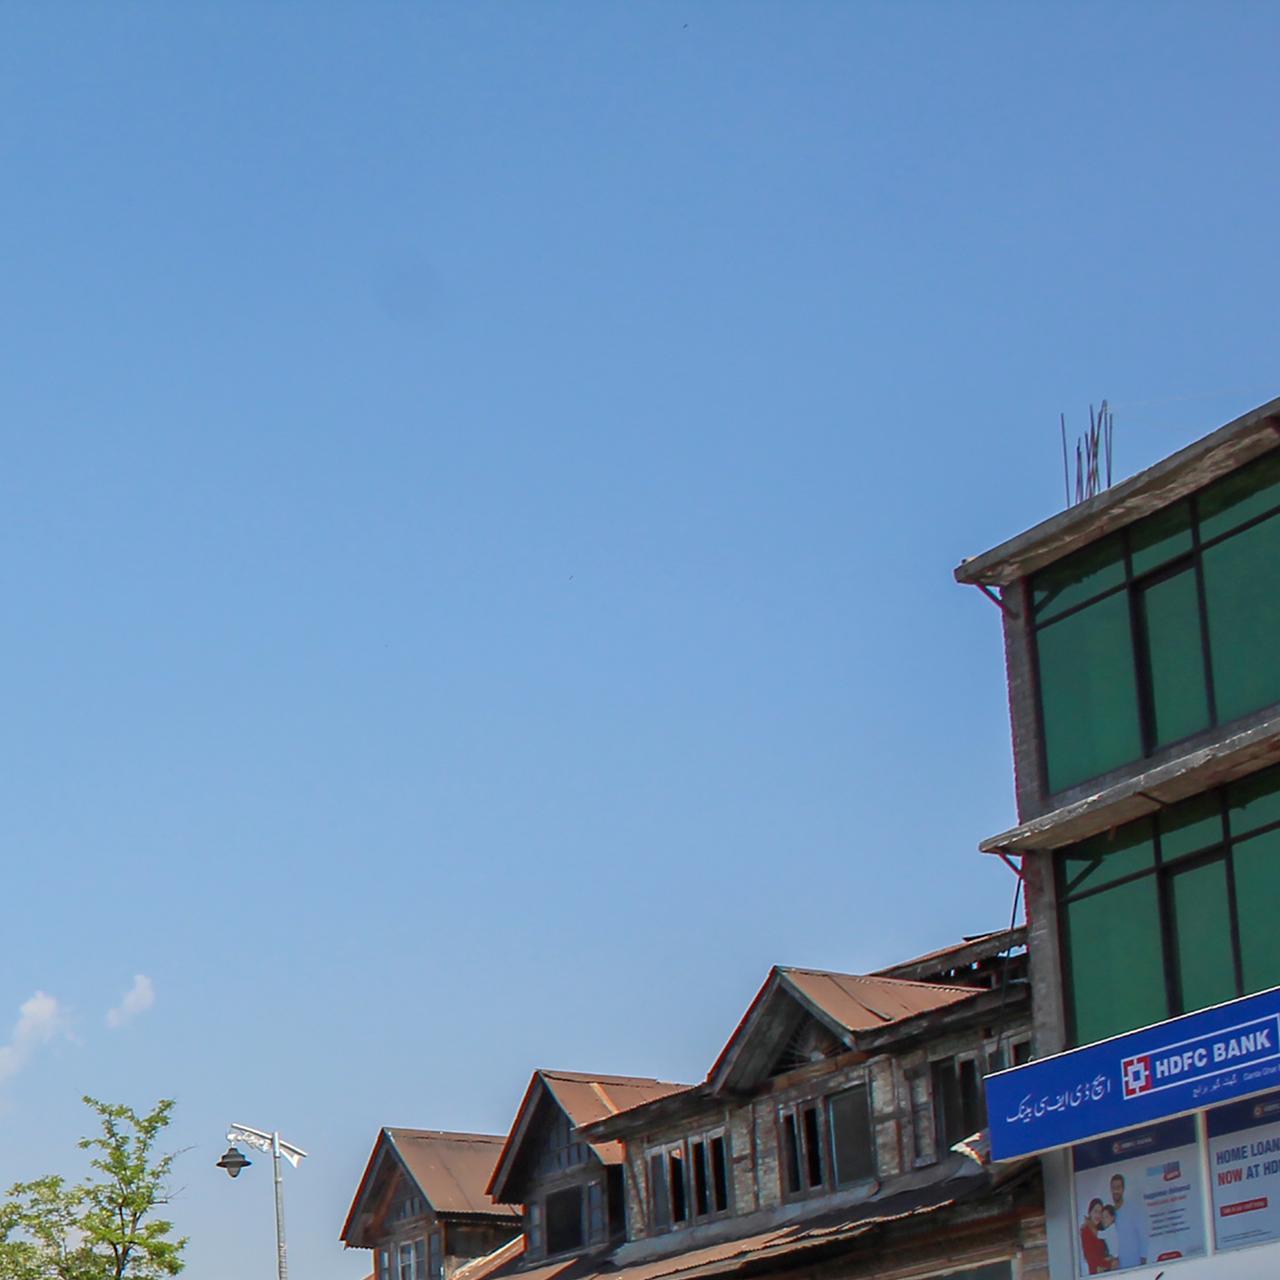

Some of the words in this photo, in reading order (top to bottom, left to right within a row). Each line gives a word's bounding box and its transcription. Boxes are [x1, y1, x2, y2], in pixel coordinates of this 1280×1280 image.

[1155, 1048, 1208, 1078] HDFC
[1212, 1028, 1272, 1063] BANK
[1216, 1150, 1248, 1165] HOME
[1218, 1167, 1243, 1186] NOW
[1246, 1164, 1261, 1180] AT
